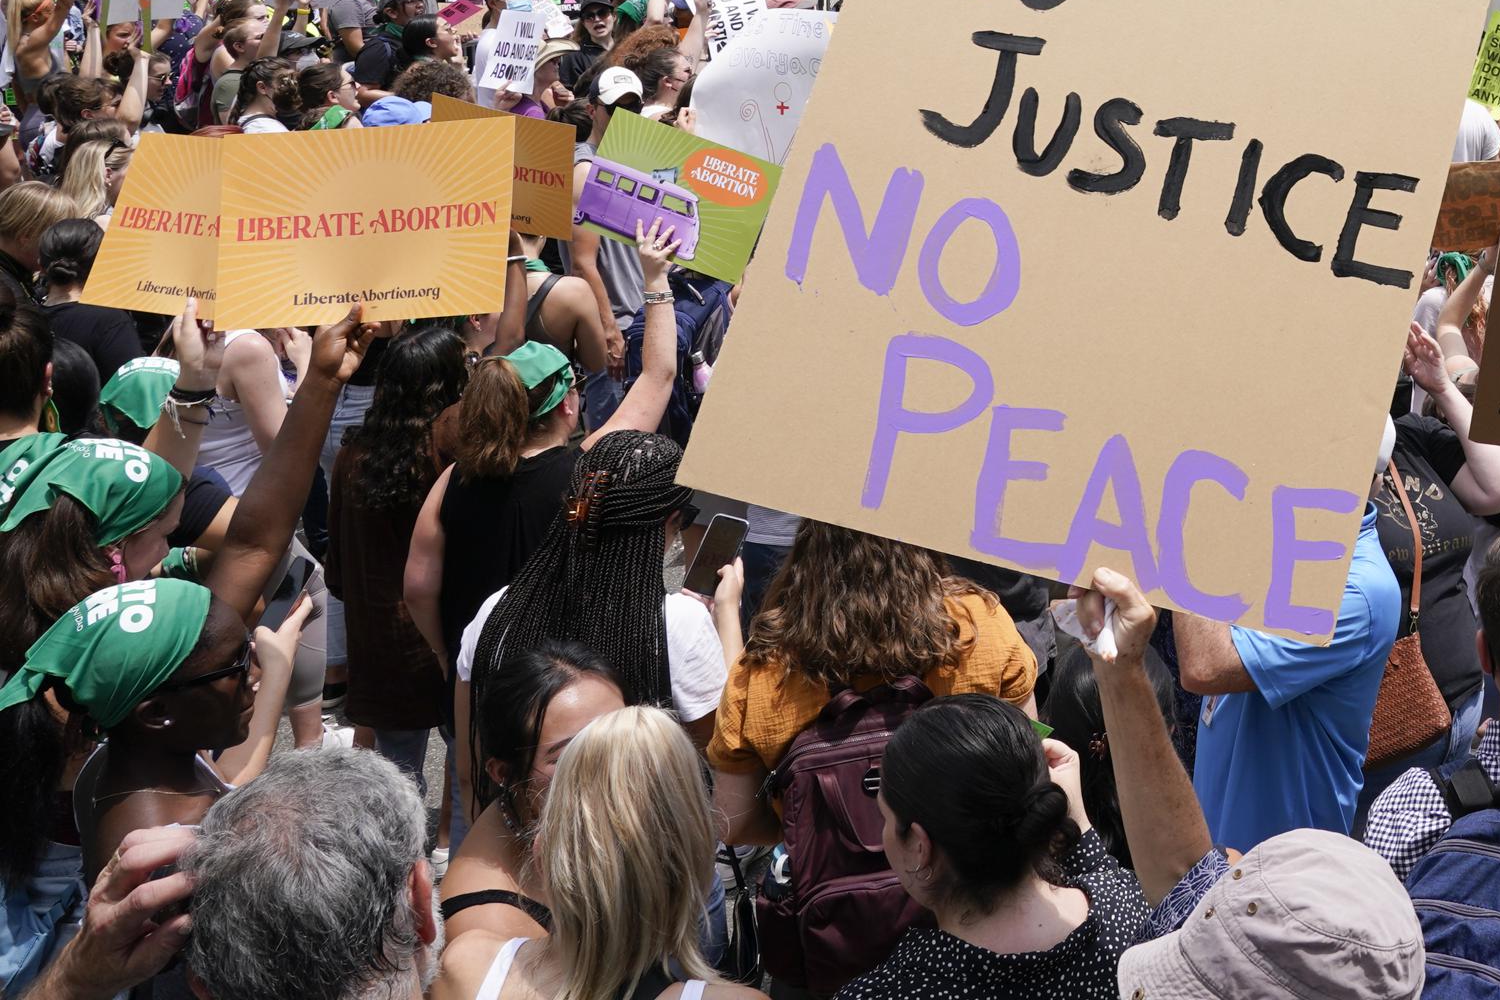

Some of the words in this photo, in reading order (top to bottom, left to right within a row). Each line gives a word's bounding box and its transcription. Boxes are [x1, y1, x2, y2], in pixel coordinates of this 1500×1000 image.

[520, 22, 535, 39] WILL
[725, 6, 744, 32] AND
[494, 41, 511, 58] AID
[510, 43, 525, 60] AND
[1477, 75, 1490, 87] IT
[703, 155, 760, 185] LIBERATE
[919, 30, 1420, 289] JUSTICE
[691, 168, 758, 199] ABORTION
[119, 205, 205, 236] LIBERATE
[236, 211, 365, 242] LIBERATE
[369, 201, 497, 233] ABORTION
[785, 143, 1021, 327] NO
[136, 279, 216, 300] LiberateAbortio
[293, 286, 441, 307] LiberateAbortion.org
[862, 332, 1361, 636] PEACE
